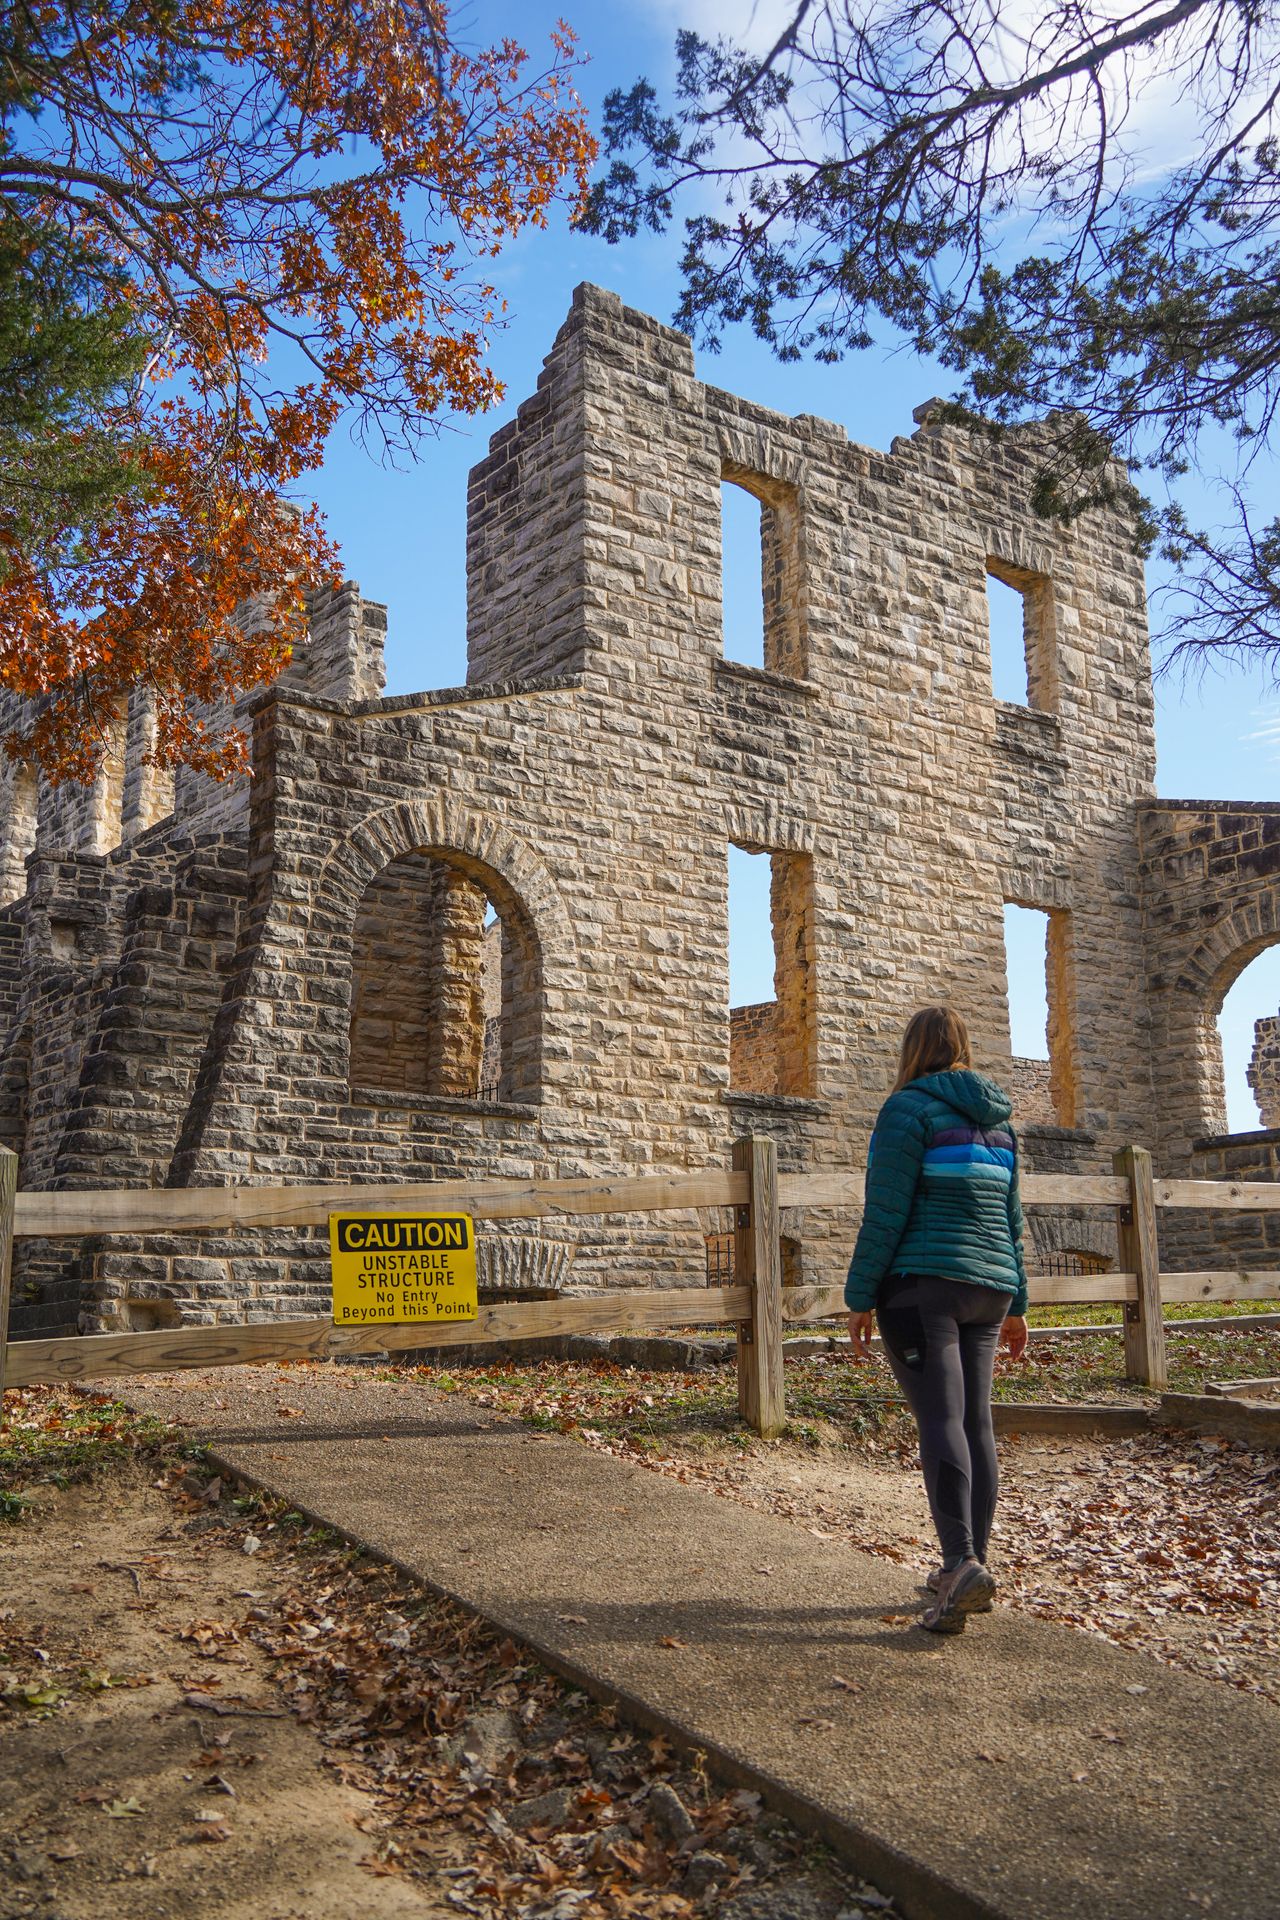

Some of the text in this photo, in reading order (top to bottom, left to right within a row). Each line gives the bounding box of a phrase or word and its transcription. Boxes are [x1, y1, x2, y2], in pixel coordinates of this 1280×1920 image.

[344, 1222, 463, 1248] CAUTION
[363, 1254, 449, 1271] UNSTABLE
[357, 1271, 455, 1289] STRUCTURE
[376, 1290, 438, 1304] No Entry
[342, 1302, 471, 1320] Beyond this Point
